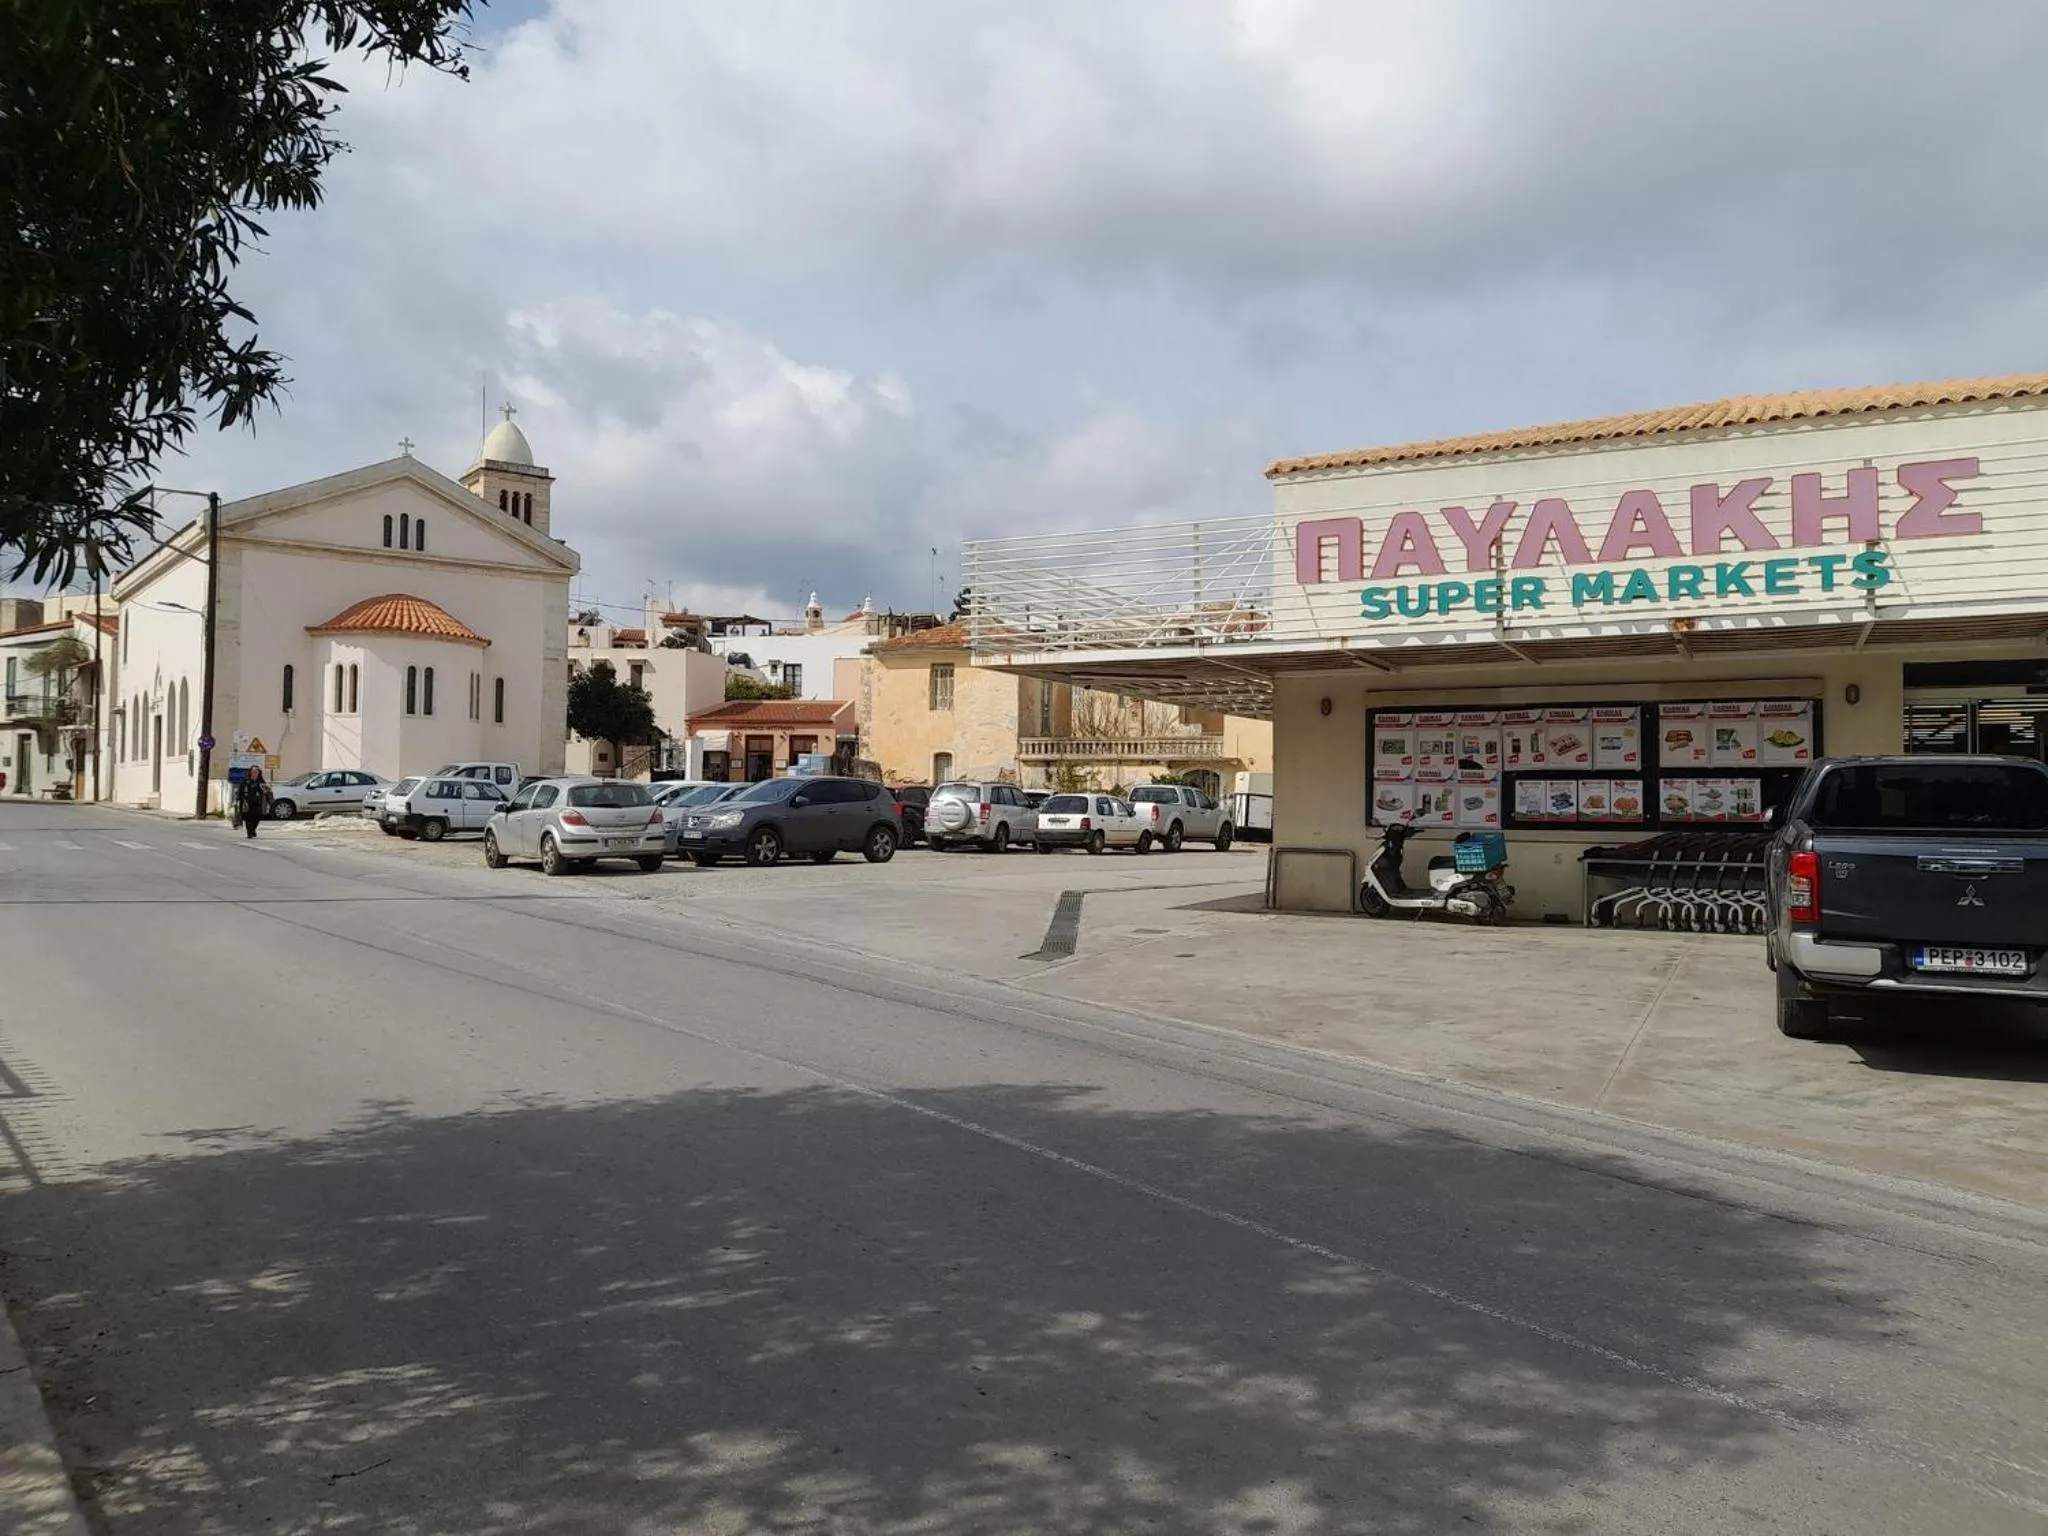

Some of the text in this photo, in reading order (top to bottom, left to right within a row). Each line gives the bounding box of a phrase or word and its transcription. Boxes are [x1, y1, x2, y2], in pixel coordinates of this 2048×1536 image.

[1296, 457, 1984, 584] ΠΑΥΛΑΚΗΣ
[1361, 550, 1891, 620] SUPER MARKETS
[1975, 951, 2023, 969] 3102
